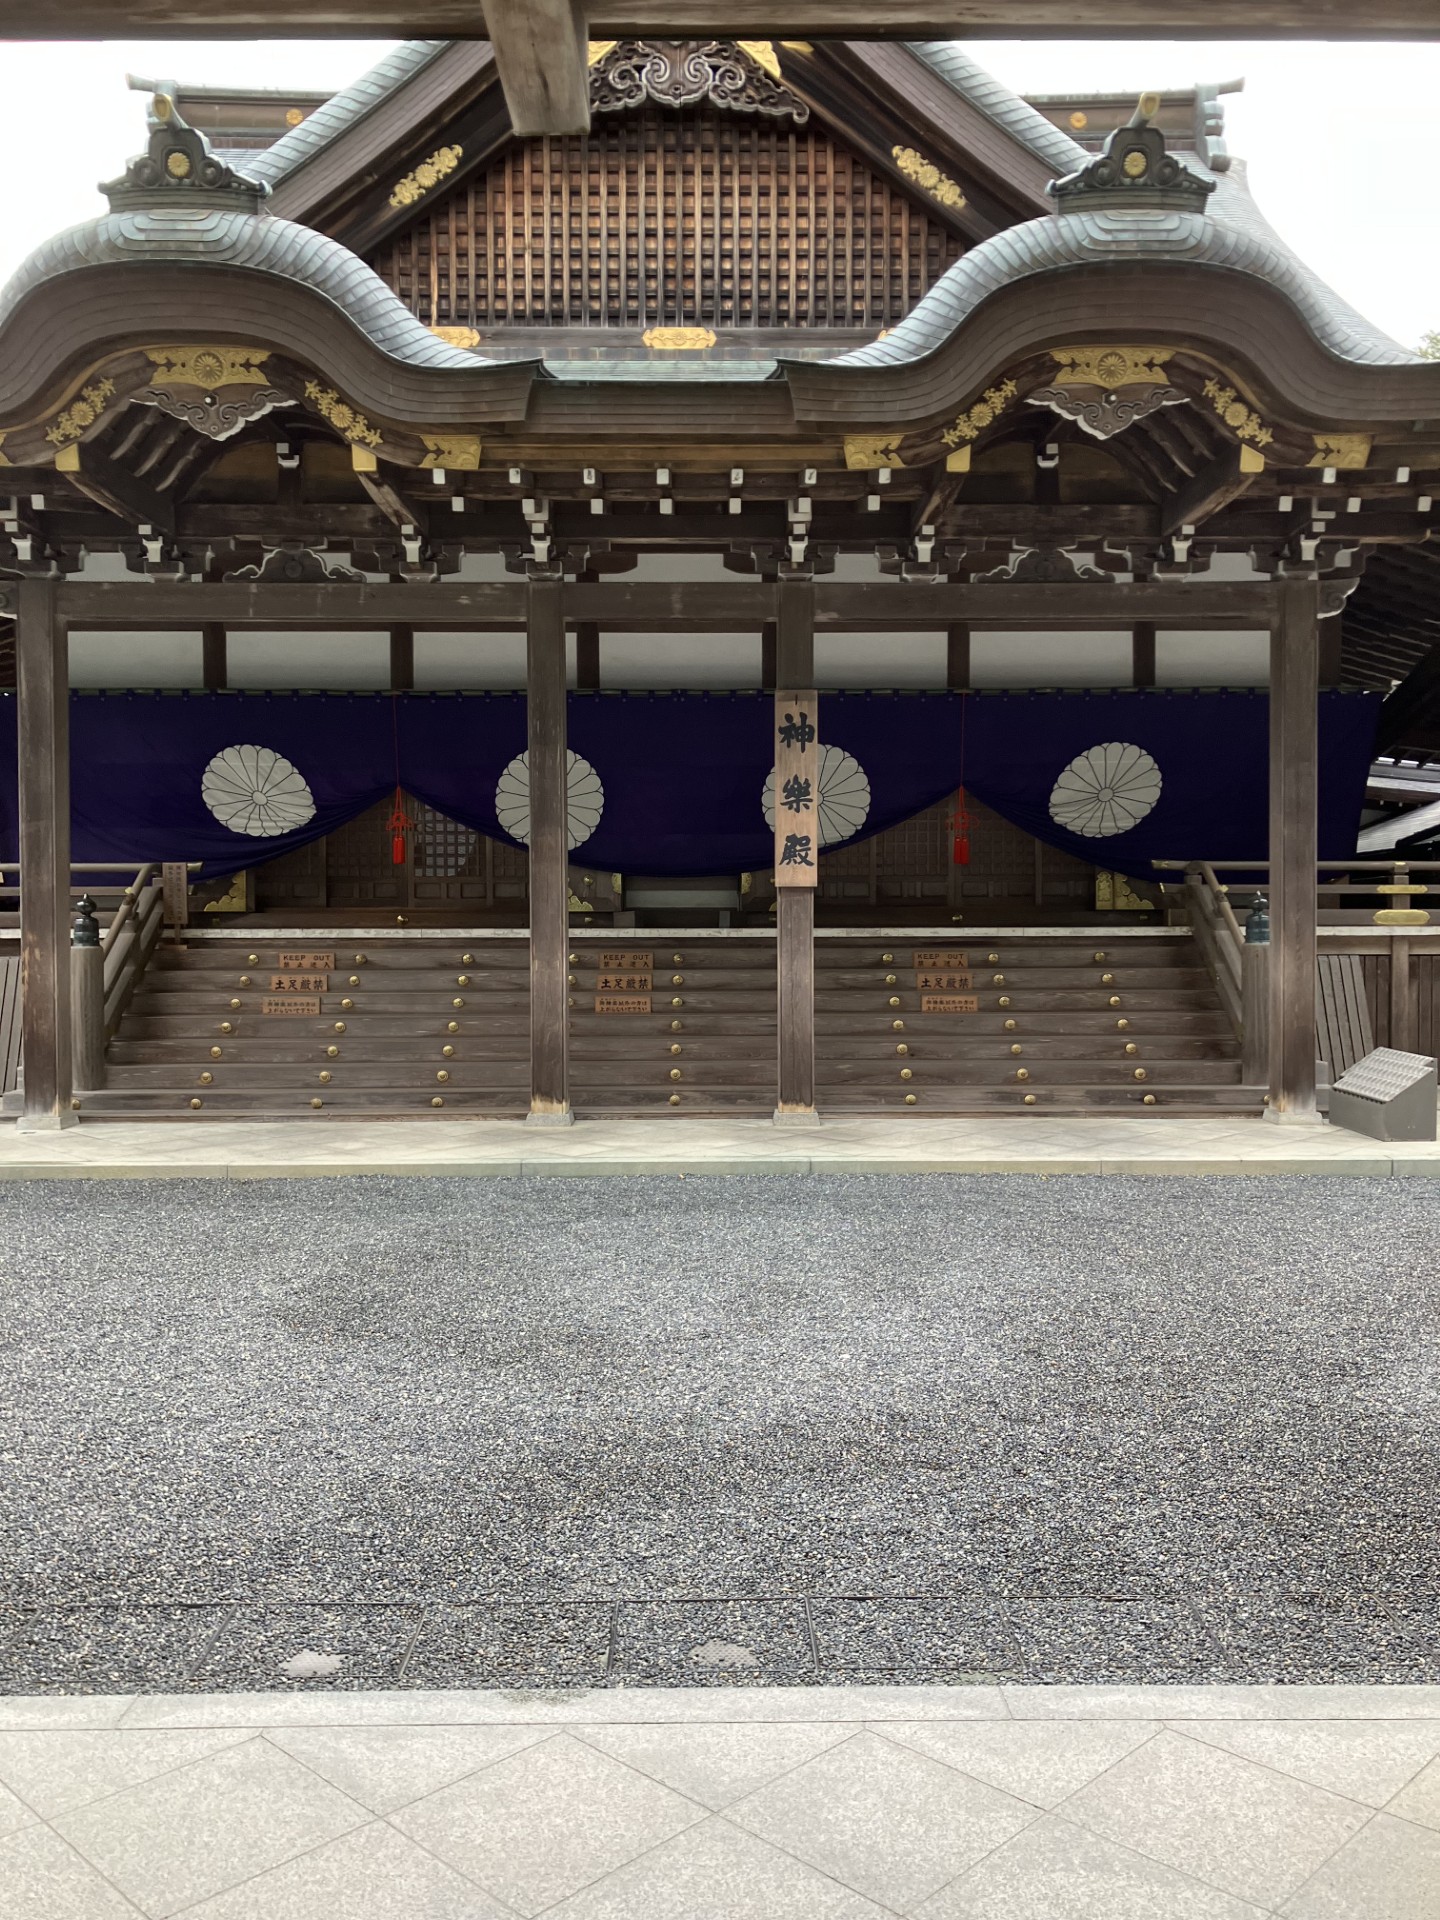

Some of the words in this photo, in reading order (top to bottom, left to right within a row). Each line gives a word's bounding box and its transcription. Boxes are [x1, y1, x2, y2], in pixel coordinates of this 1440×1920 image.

[778, 711, 815, 867] 神樂殿
[275, 979, 324, 991] 土足厳禁
[601, 978, 649, 989] 土足厳禁
[921, 977, 969, 989] 土足厳禁
